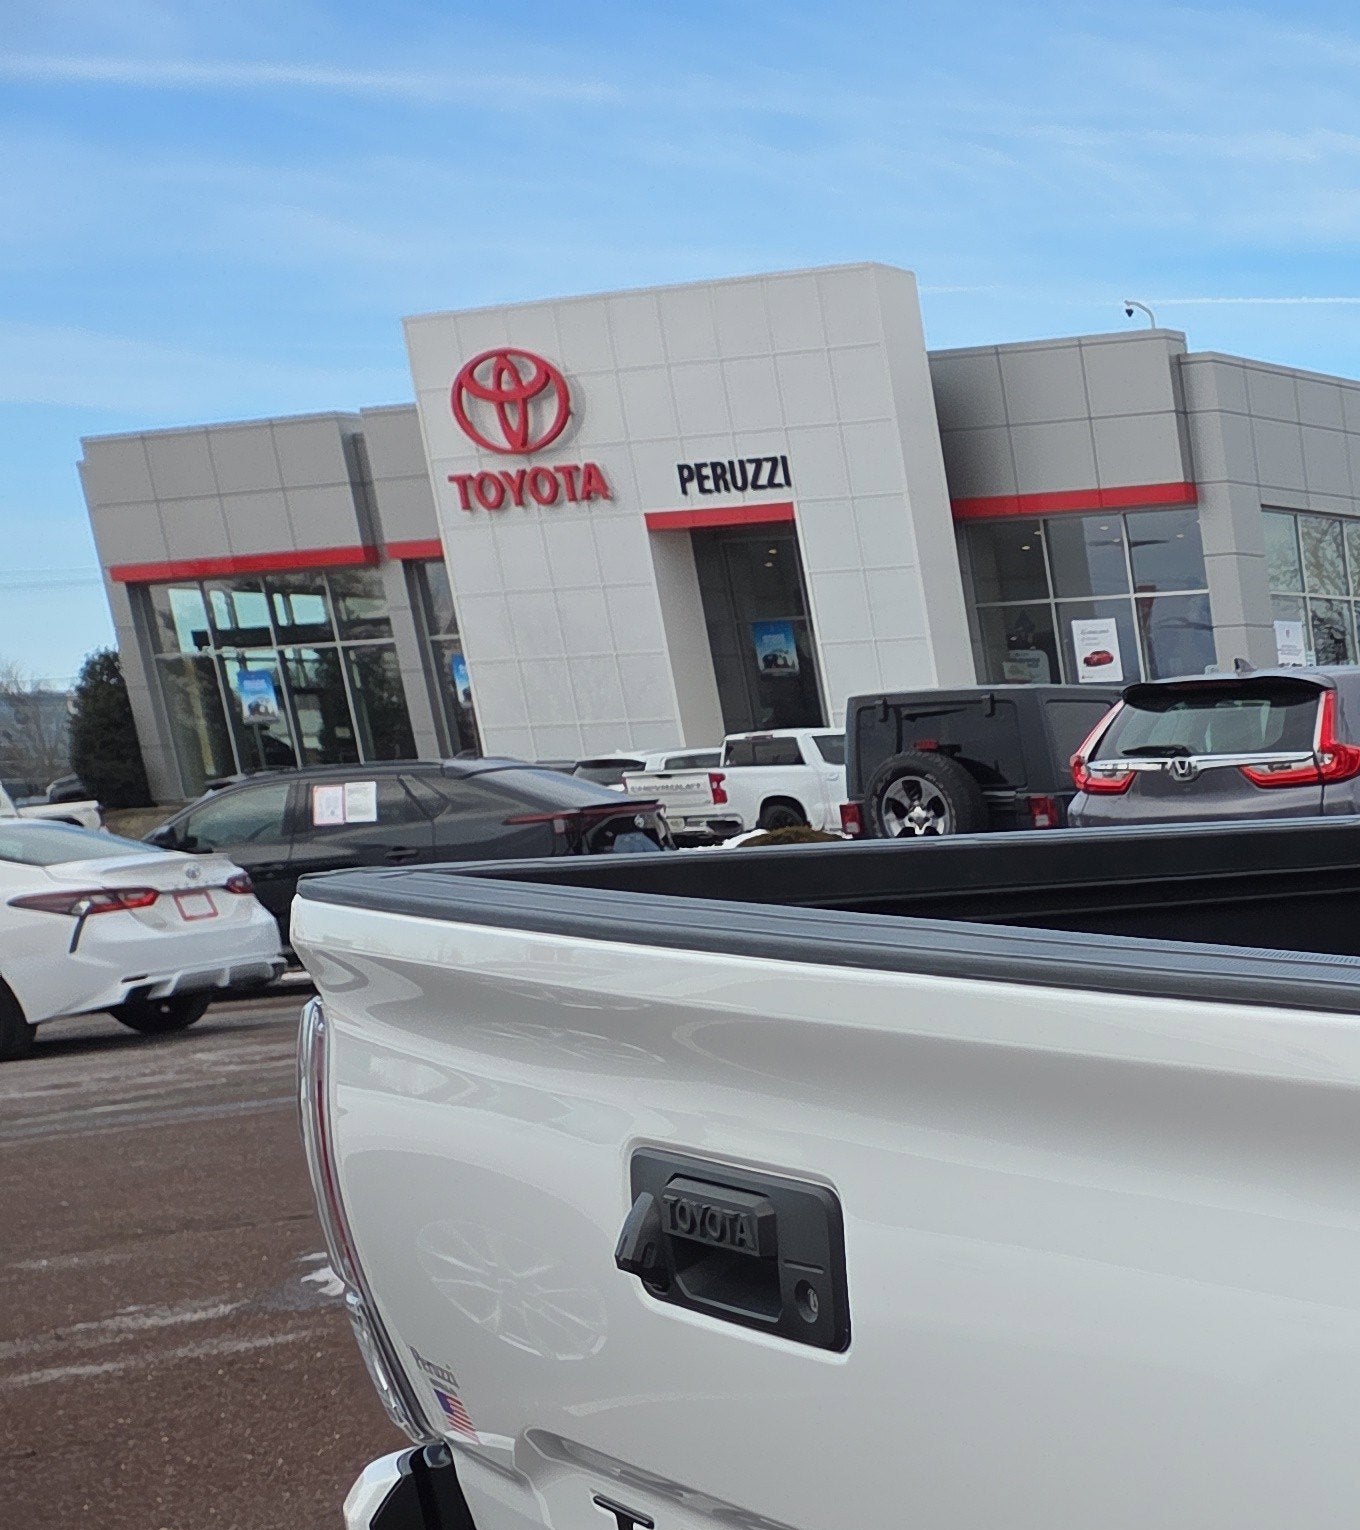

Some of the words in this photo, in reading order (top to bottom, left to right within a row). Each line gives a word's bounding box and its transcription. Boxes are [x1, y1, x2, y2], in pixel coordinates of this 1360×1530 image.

[448, 462, 612, 511] TOYOTA
[677, 455, 793, 496] PERUZZI
[663, 1194, 760, 1254] TOYOTA
